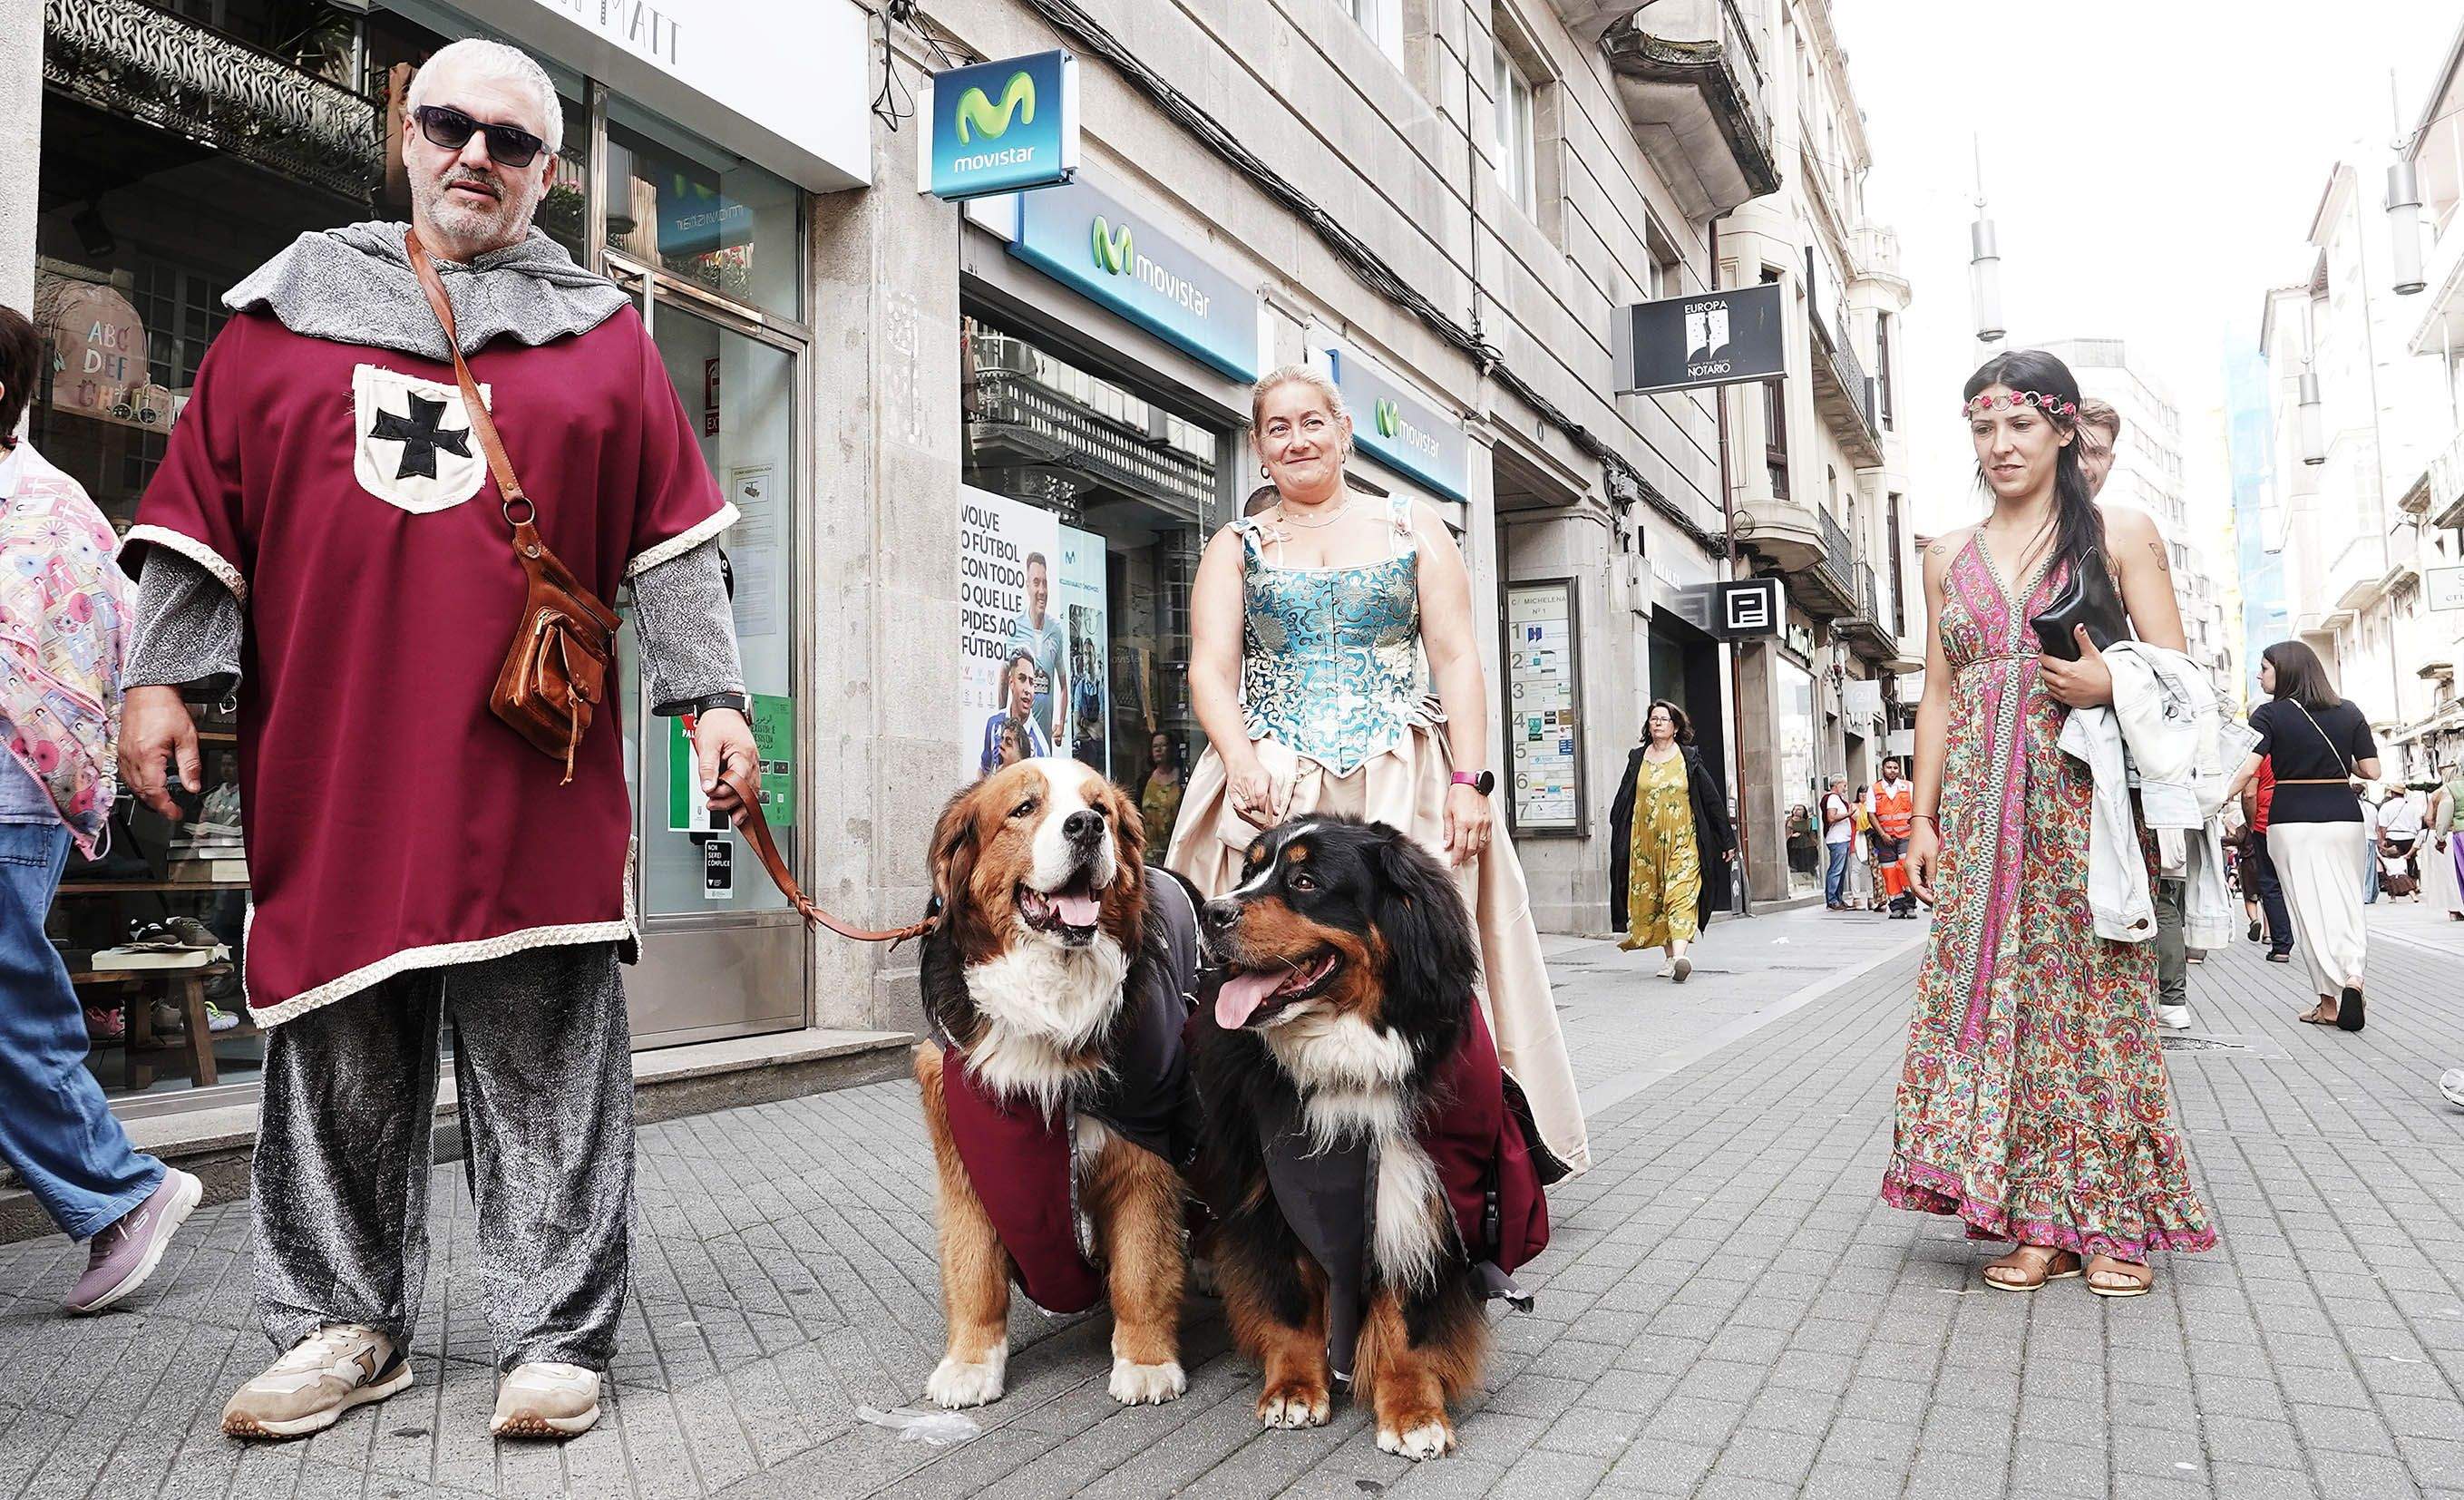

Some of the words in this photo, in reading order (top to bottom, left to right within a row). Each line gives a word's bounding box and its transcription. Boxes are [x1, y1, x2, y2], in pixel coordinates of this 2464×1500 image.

[954, 146, 1036, 173] movistar
[1136, 254, 1211, 319] movistar
[1684, 300, 1728, 314] EUROPA
[88, 320, 130, 352] ABC
[83, 348, 129, 381] DEF
[1688, 363, 1730, 377] NOTARIO
[1399, 419, 1439, 458] movistar
[961, 502, 999, 532] VOLVE
[961, 530, 970, 550] O
[973, 529, 1020, 563] FÚTBOL
[961, 556, 989, 580] CON
[989, 562, 1025, 589] TODO
[961, 582, 970, 601] O
[973, 585, 999, 609] QUE
[1002, 592, 1022, 613] LLE
[1524, 596, 1566, 605] MICHELENA
[961, 609, 997, 634] PIDES
[998, 616, 1017, 638] AO
[1512, 623, 1520, 639] 1
[961, 631, 1010, 662] FÚTBOL
[1512, 653, 1524, 669] 2
[1513, 683, 1524, 699] 3
[1513, 713, 1525, 728] 4
[1514, 743, 1527, 759] 5
[1515, 773, 1528, 790] 6
[1517, 803, 1528, 820] 7
